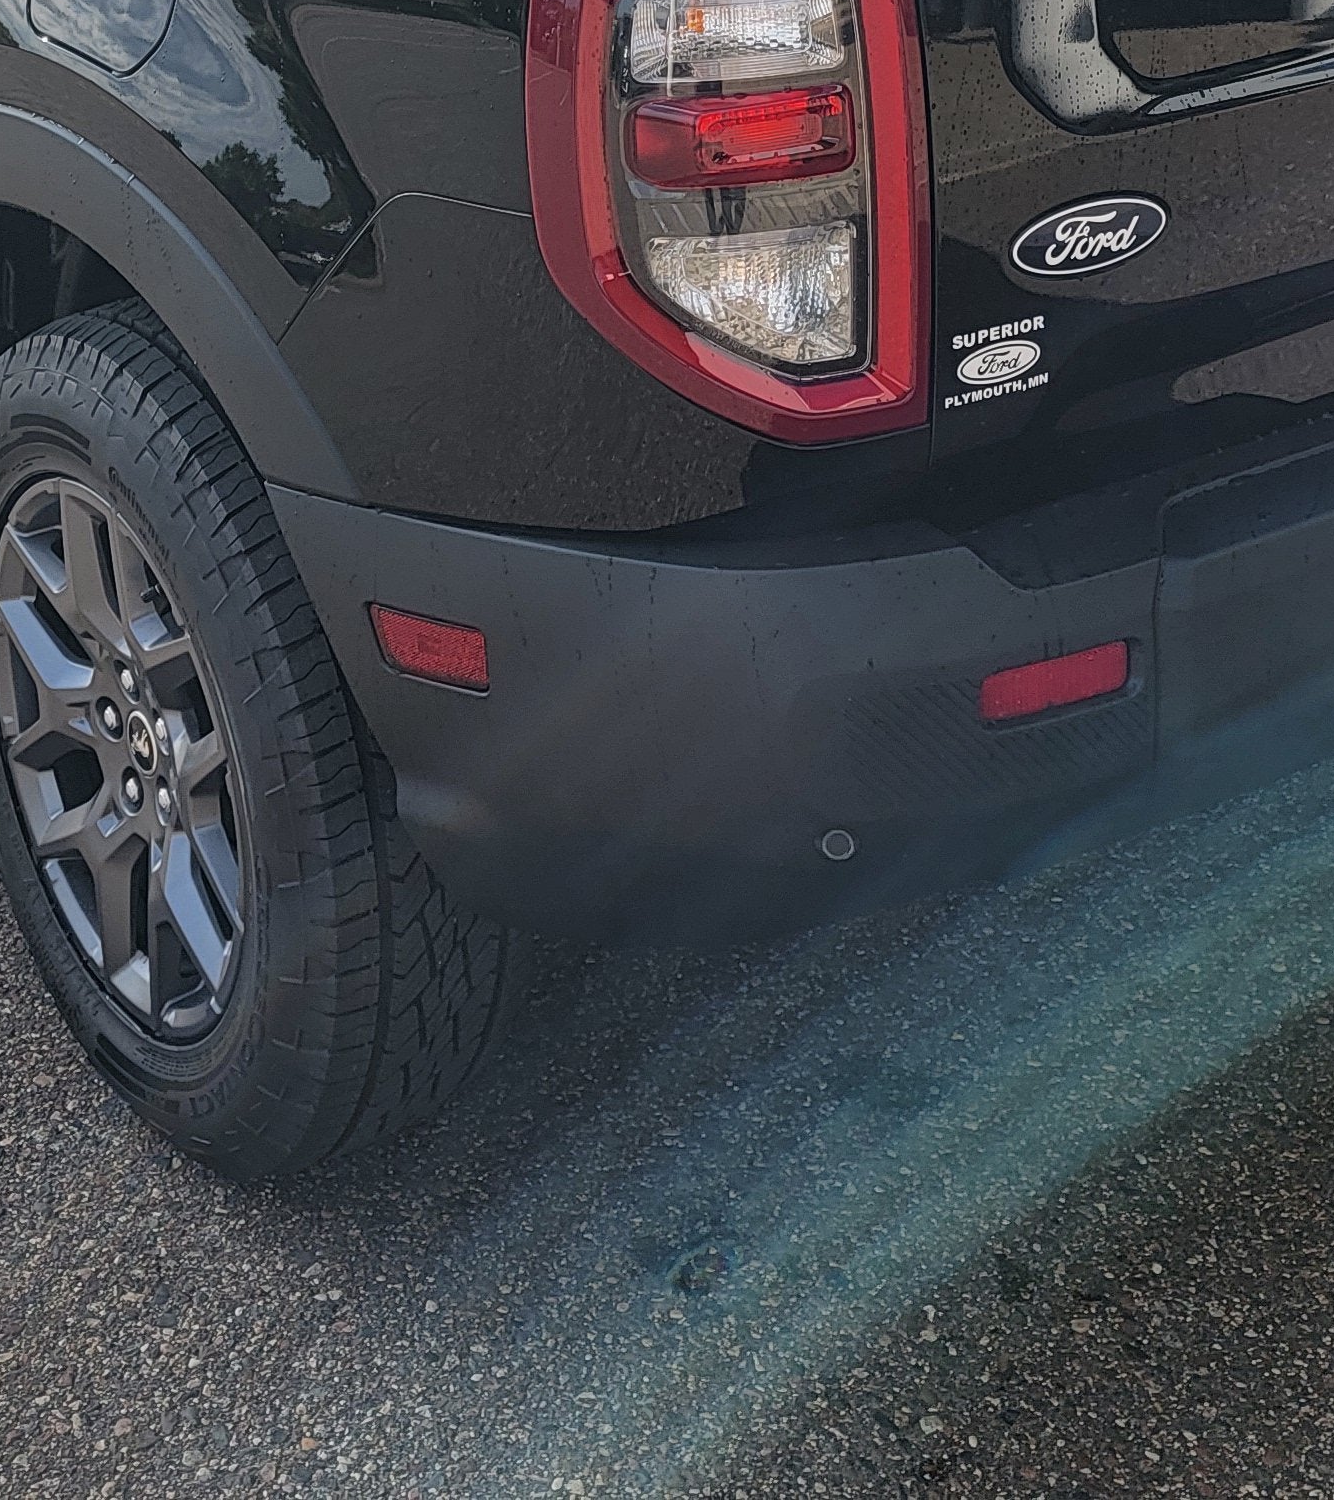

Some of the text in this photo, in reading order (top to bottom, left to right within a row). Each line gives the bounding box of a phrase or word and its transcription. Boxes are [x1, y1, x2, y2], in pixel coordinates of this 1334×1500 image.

[1044, 210, 1140, 266] Ford
[952, 315, 1045, 350] SUPERIOR
[977, 350, 1022, 376] Ford
